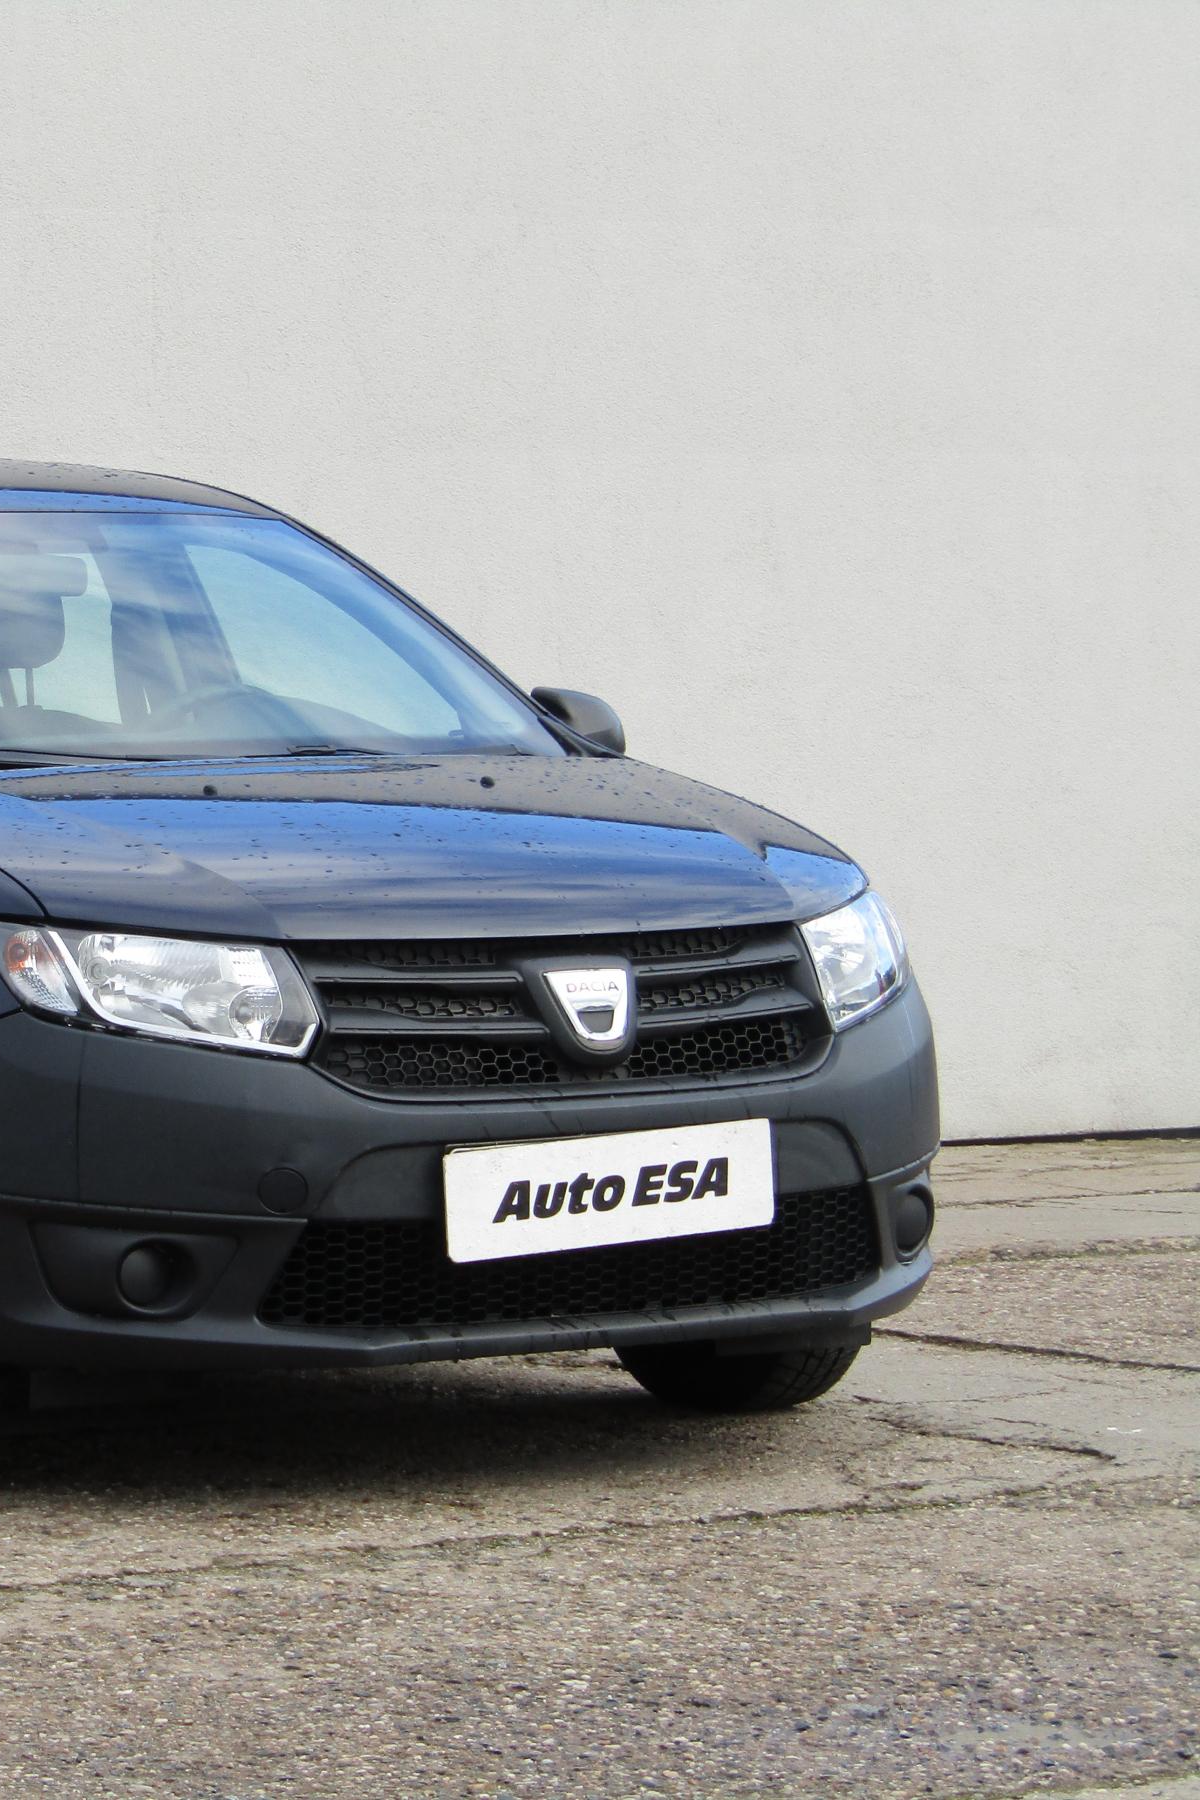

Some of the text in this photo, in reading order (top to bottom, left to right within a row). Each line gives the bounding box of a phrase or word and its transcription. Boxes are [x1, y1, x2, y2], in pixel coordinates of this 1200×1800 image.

[566, 981, 620, 993] DACIA
[492, 1157, 729, 1224] Auto ESA
